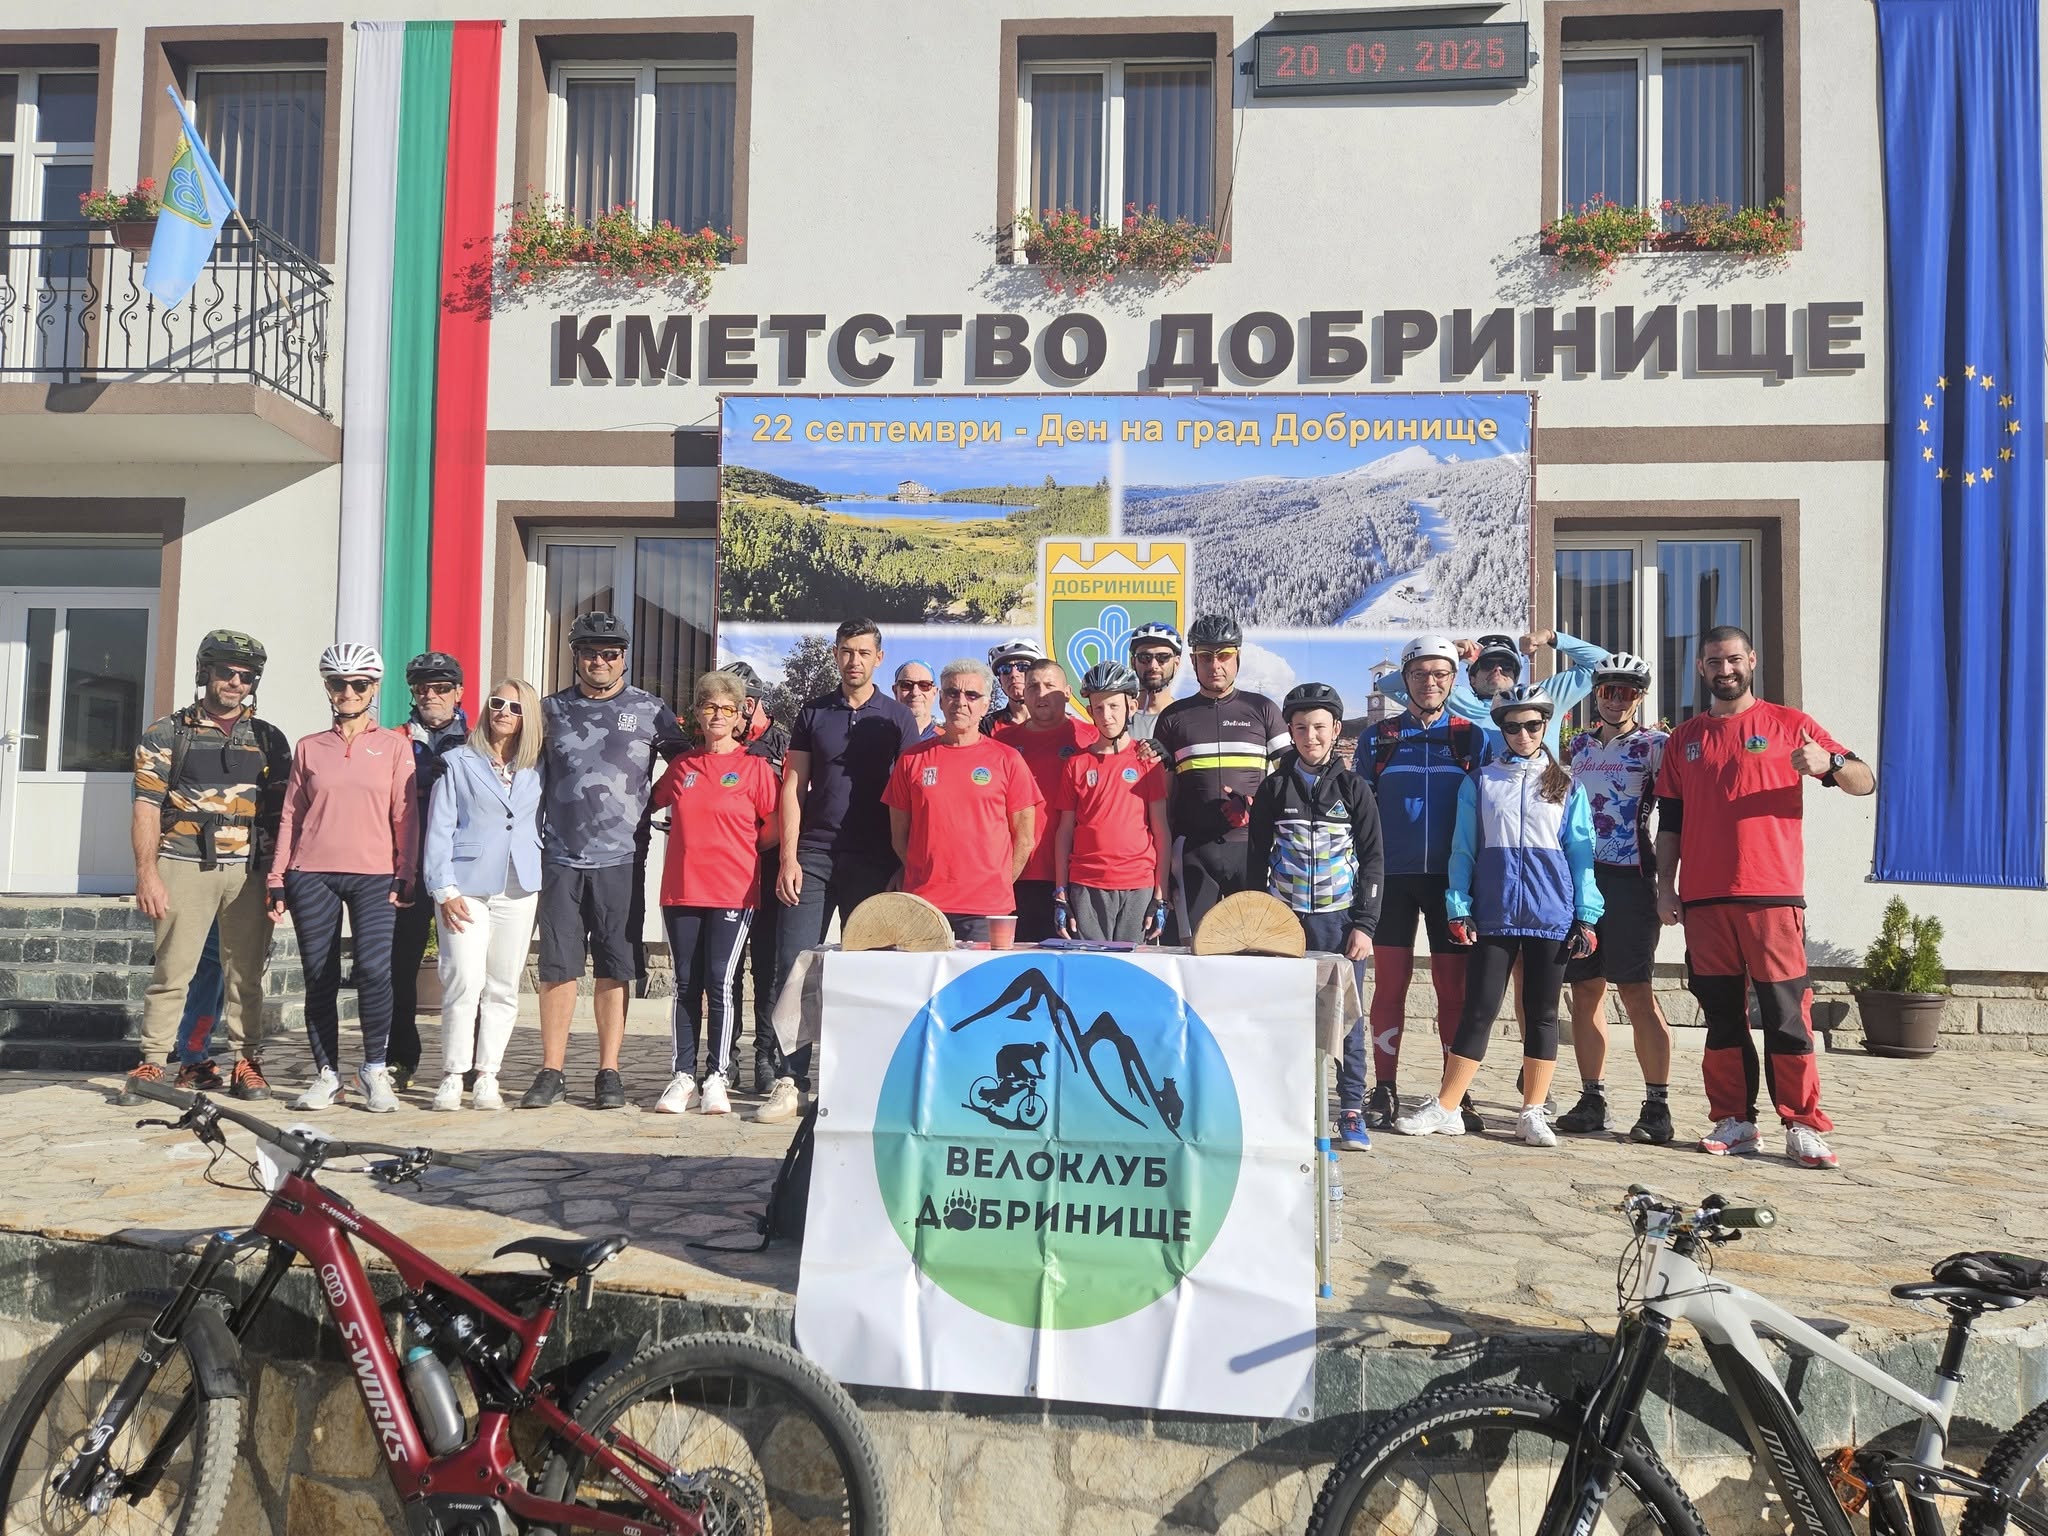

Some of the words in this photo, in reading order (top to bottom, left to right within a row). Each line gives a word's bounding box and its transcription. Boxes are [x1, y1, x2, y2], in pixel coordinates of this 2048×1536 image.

[1276, 38, 1505, 77] 20.09.2025
[558, 313, 1107, 381] КМЕТСТВО
[1148, 301, 1866, 388] ДОБРИНИЩЕ
[752, 414, 793, 442] 22
[805, 419, 1001, 449] септември
[1037, 413, 1108, 447] Ден
[1122, 419, 1163, 441] на
[1176, 419, 1260, 449] град
[1271, 412, 1498, 448] Добринище
[1052, 580, 1177, 596] ДОБРИНИЩЕ
[946, 1146, 1168, 1188] ВЕЛОКЛУБ
[340, 1321, 408, 1462] S-WORKS
[1377, 1407, 1483, 1462] SCORPION
